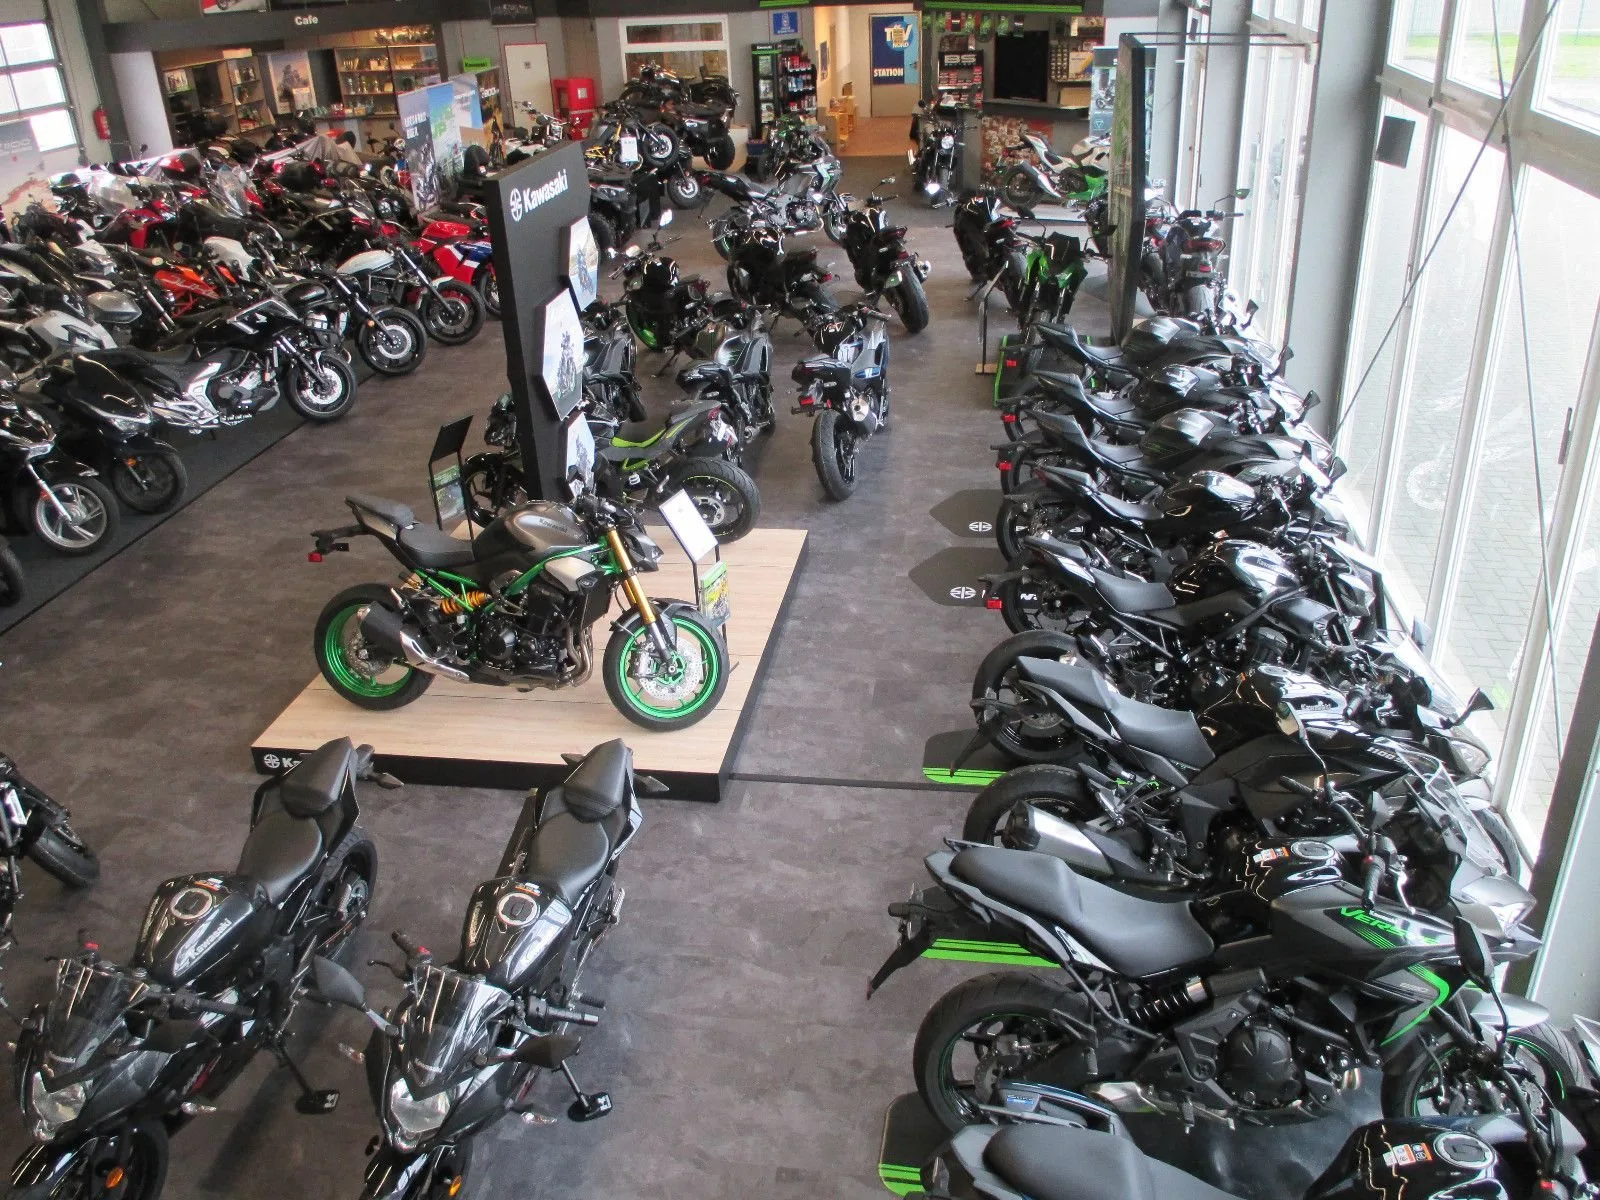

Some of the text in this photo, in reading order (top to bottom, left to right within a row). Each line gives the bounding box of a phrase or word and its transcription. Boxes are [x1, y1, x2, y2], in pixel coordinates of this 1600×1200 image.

[884, 24, 912, 41] TV
[944, 54, 976, 63] BS
[873, 68, 904, 77] STATION
[523, 168, 569, 213] Kawasaki
